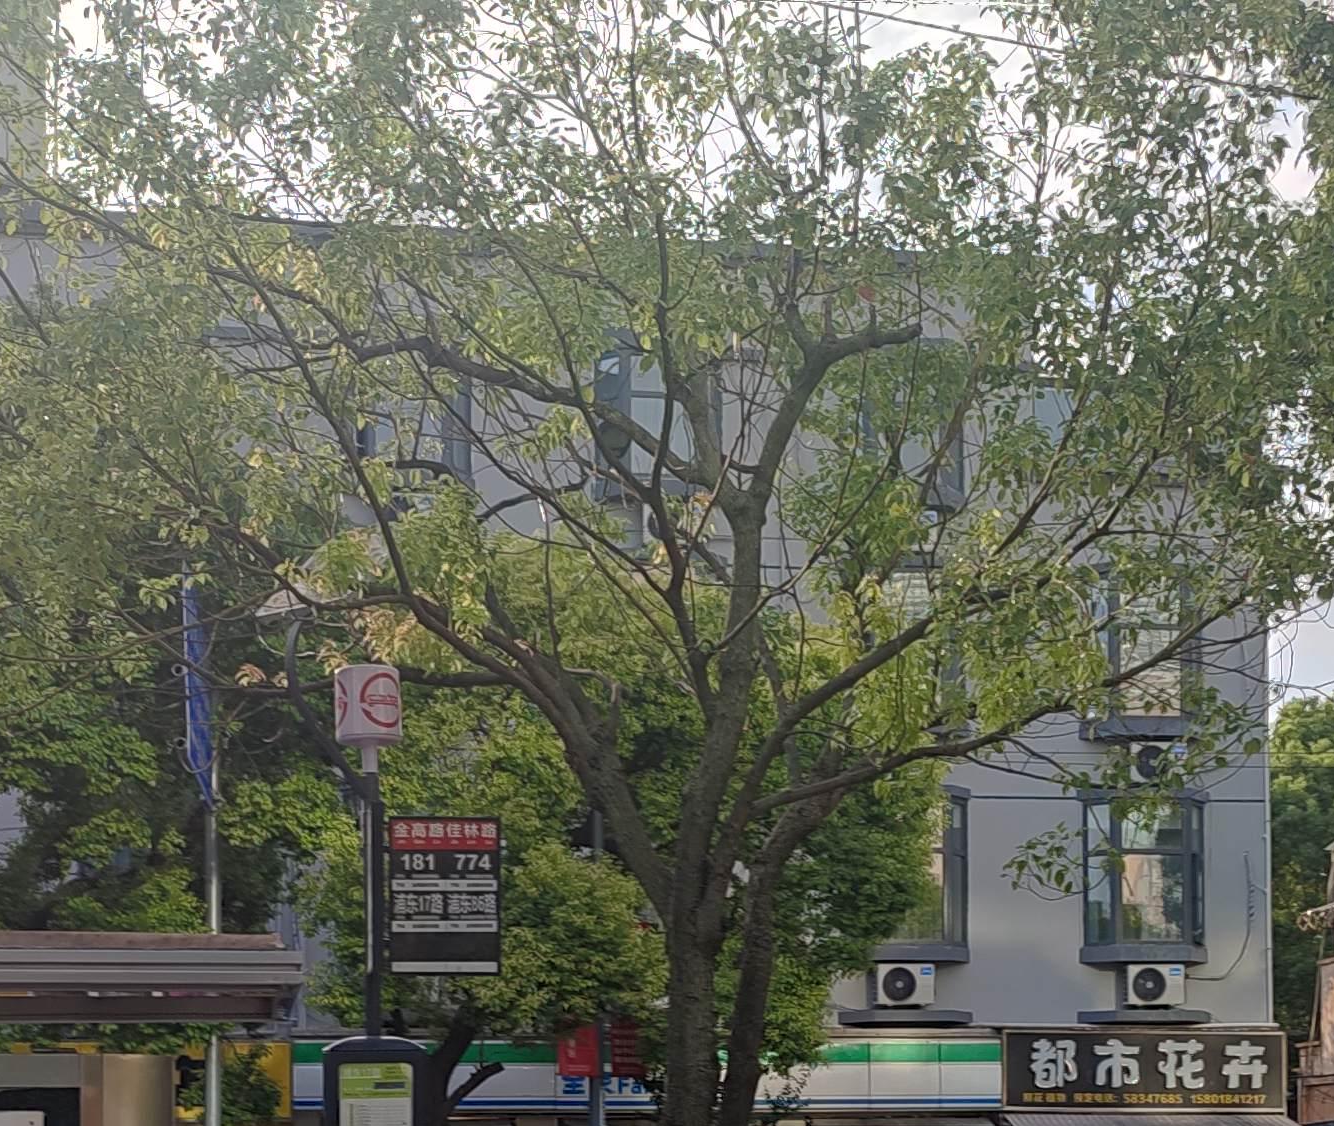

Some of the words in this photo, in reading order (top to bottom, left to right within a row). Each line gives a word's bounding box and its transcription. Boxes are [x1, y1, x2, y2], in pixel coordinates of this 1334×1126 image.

[393, 822, 497, 839] 金高路佳林路
[400, 853, 436, 871] 181
[454, 853, 492, 871] 774
[1029, 1038, 1269, 1091] 都市花卉
